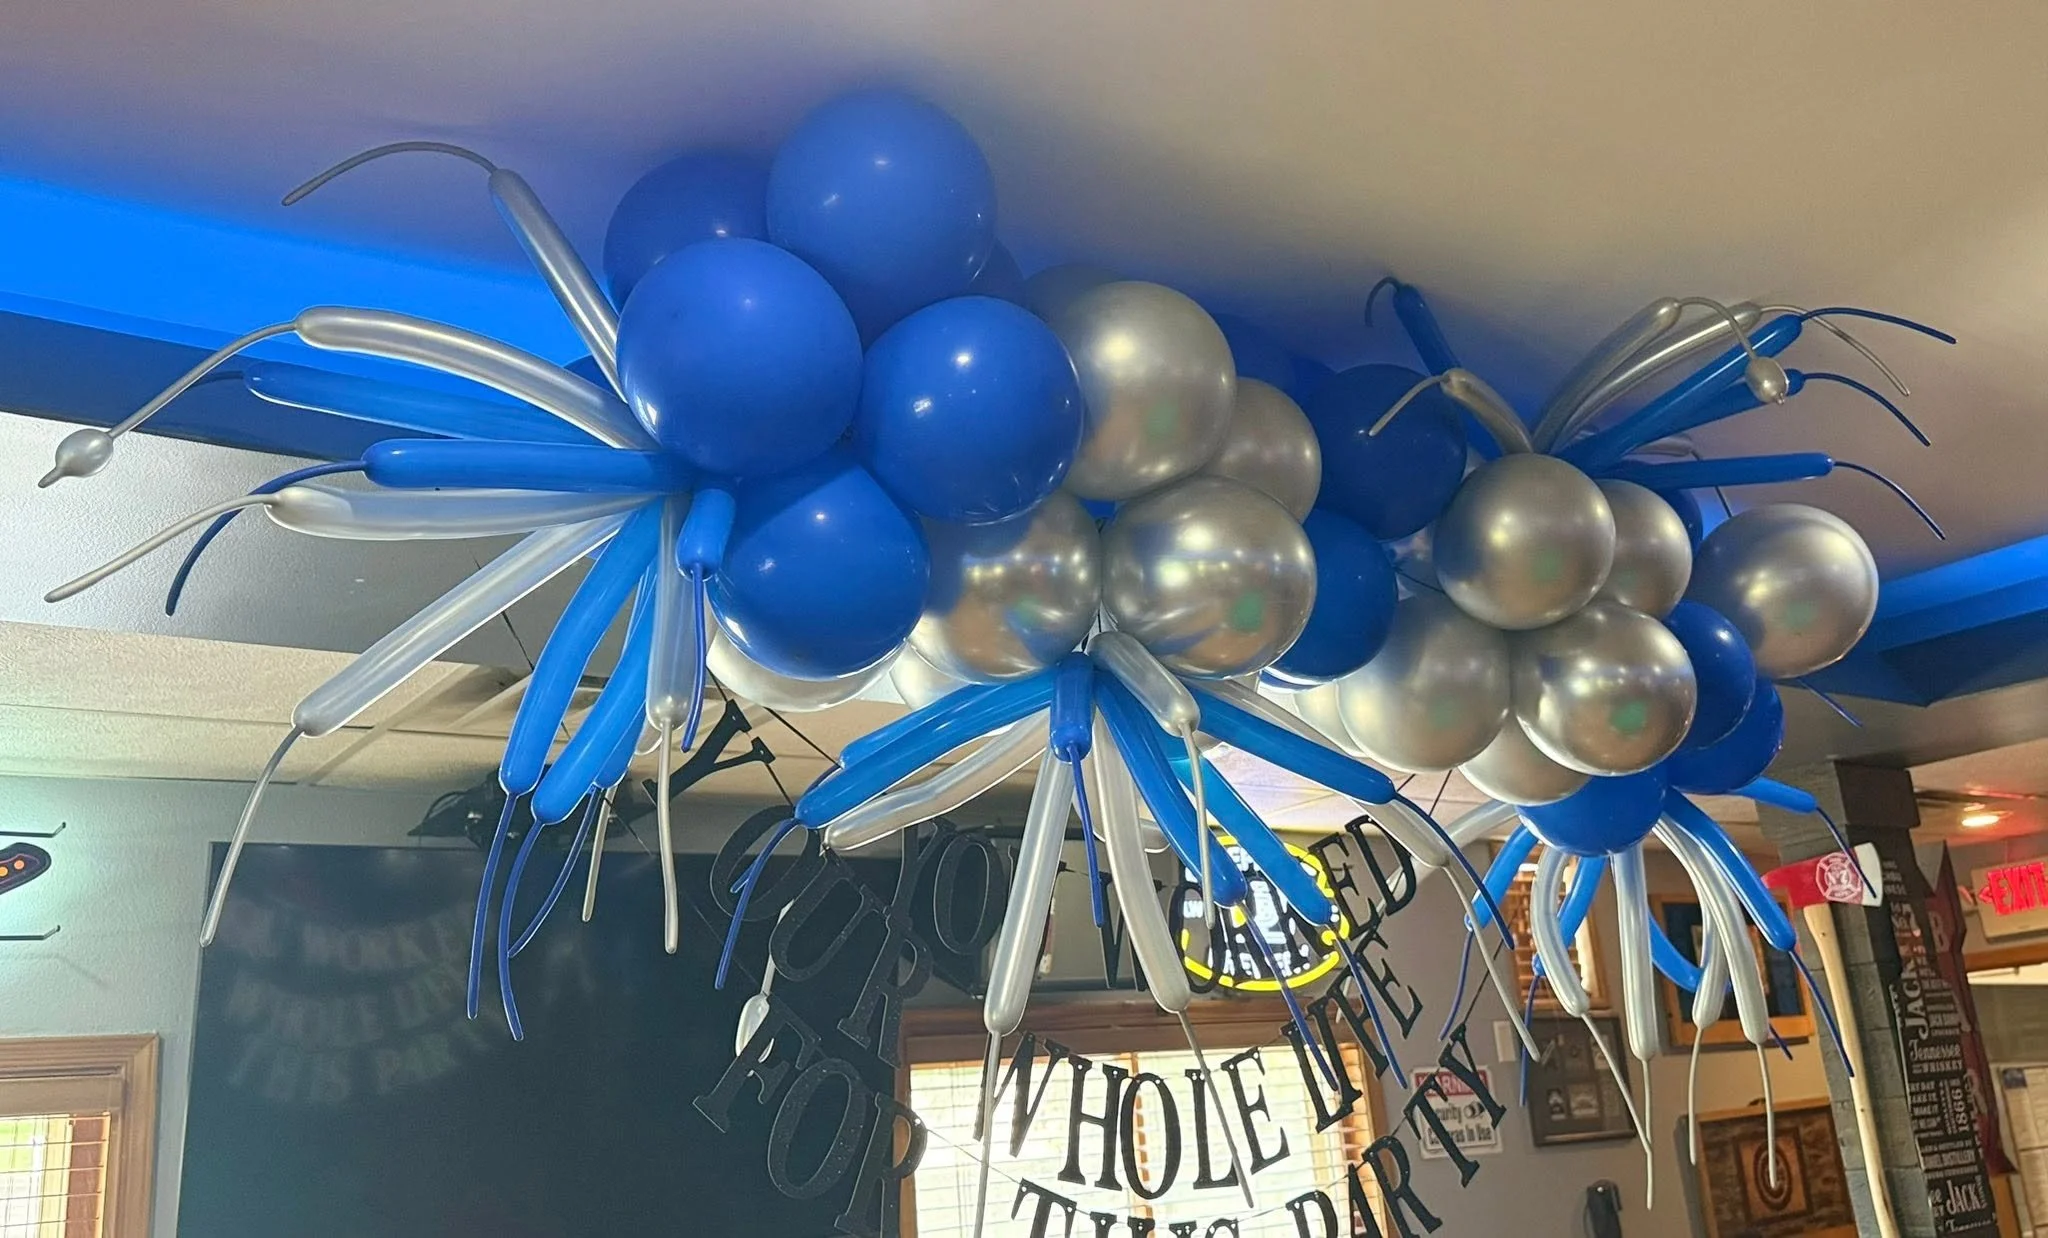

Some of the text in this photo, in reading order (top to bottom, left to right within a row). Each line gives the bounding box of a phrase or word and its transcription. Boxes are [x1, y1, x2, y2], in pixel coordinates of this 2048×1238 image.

[1987, 861, 2048, 917] EXIT
[1908, 1039, 1961, 1061] Tennessee
[693, 992, 928, 1238] FOR
[974, 1030, 1290, 1200] WHOLE
[1951, 1087, 1970, 1132] 1866
[1946, 1179, 1981, 1215] JACK
